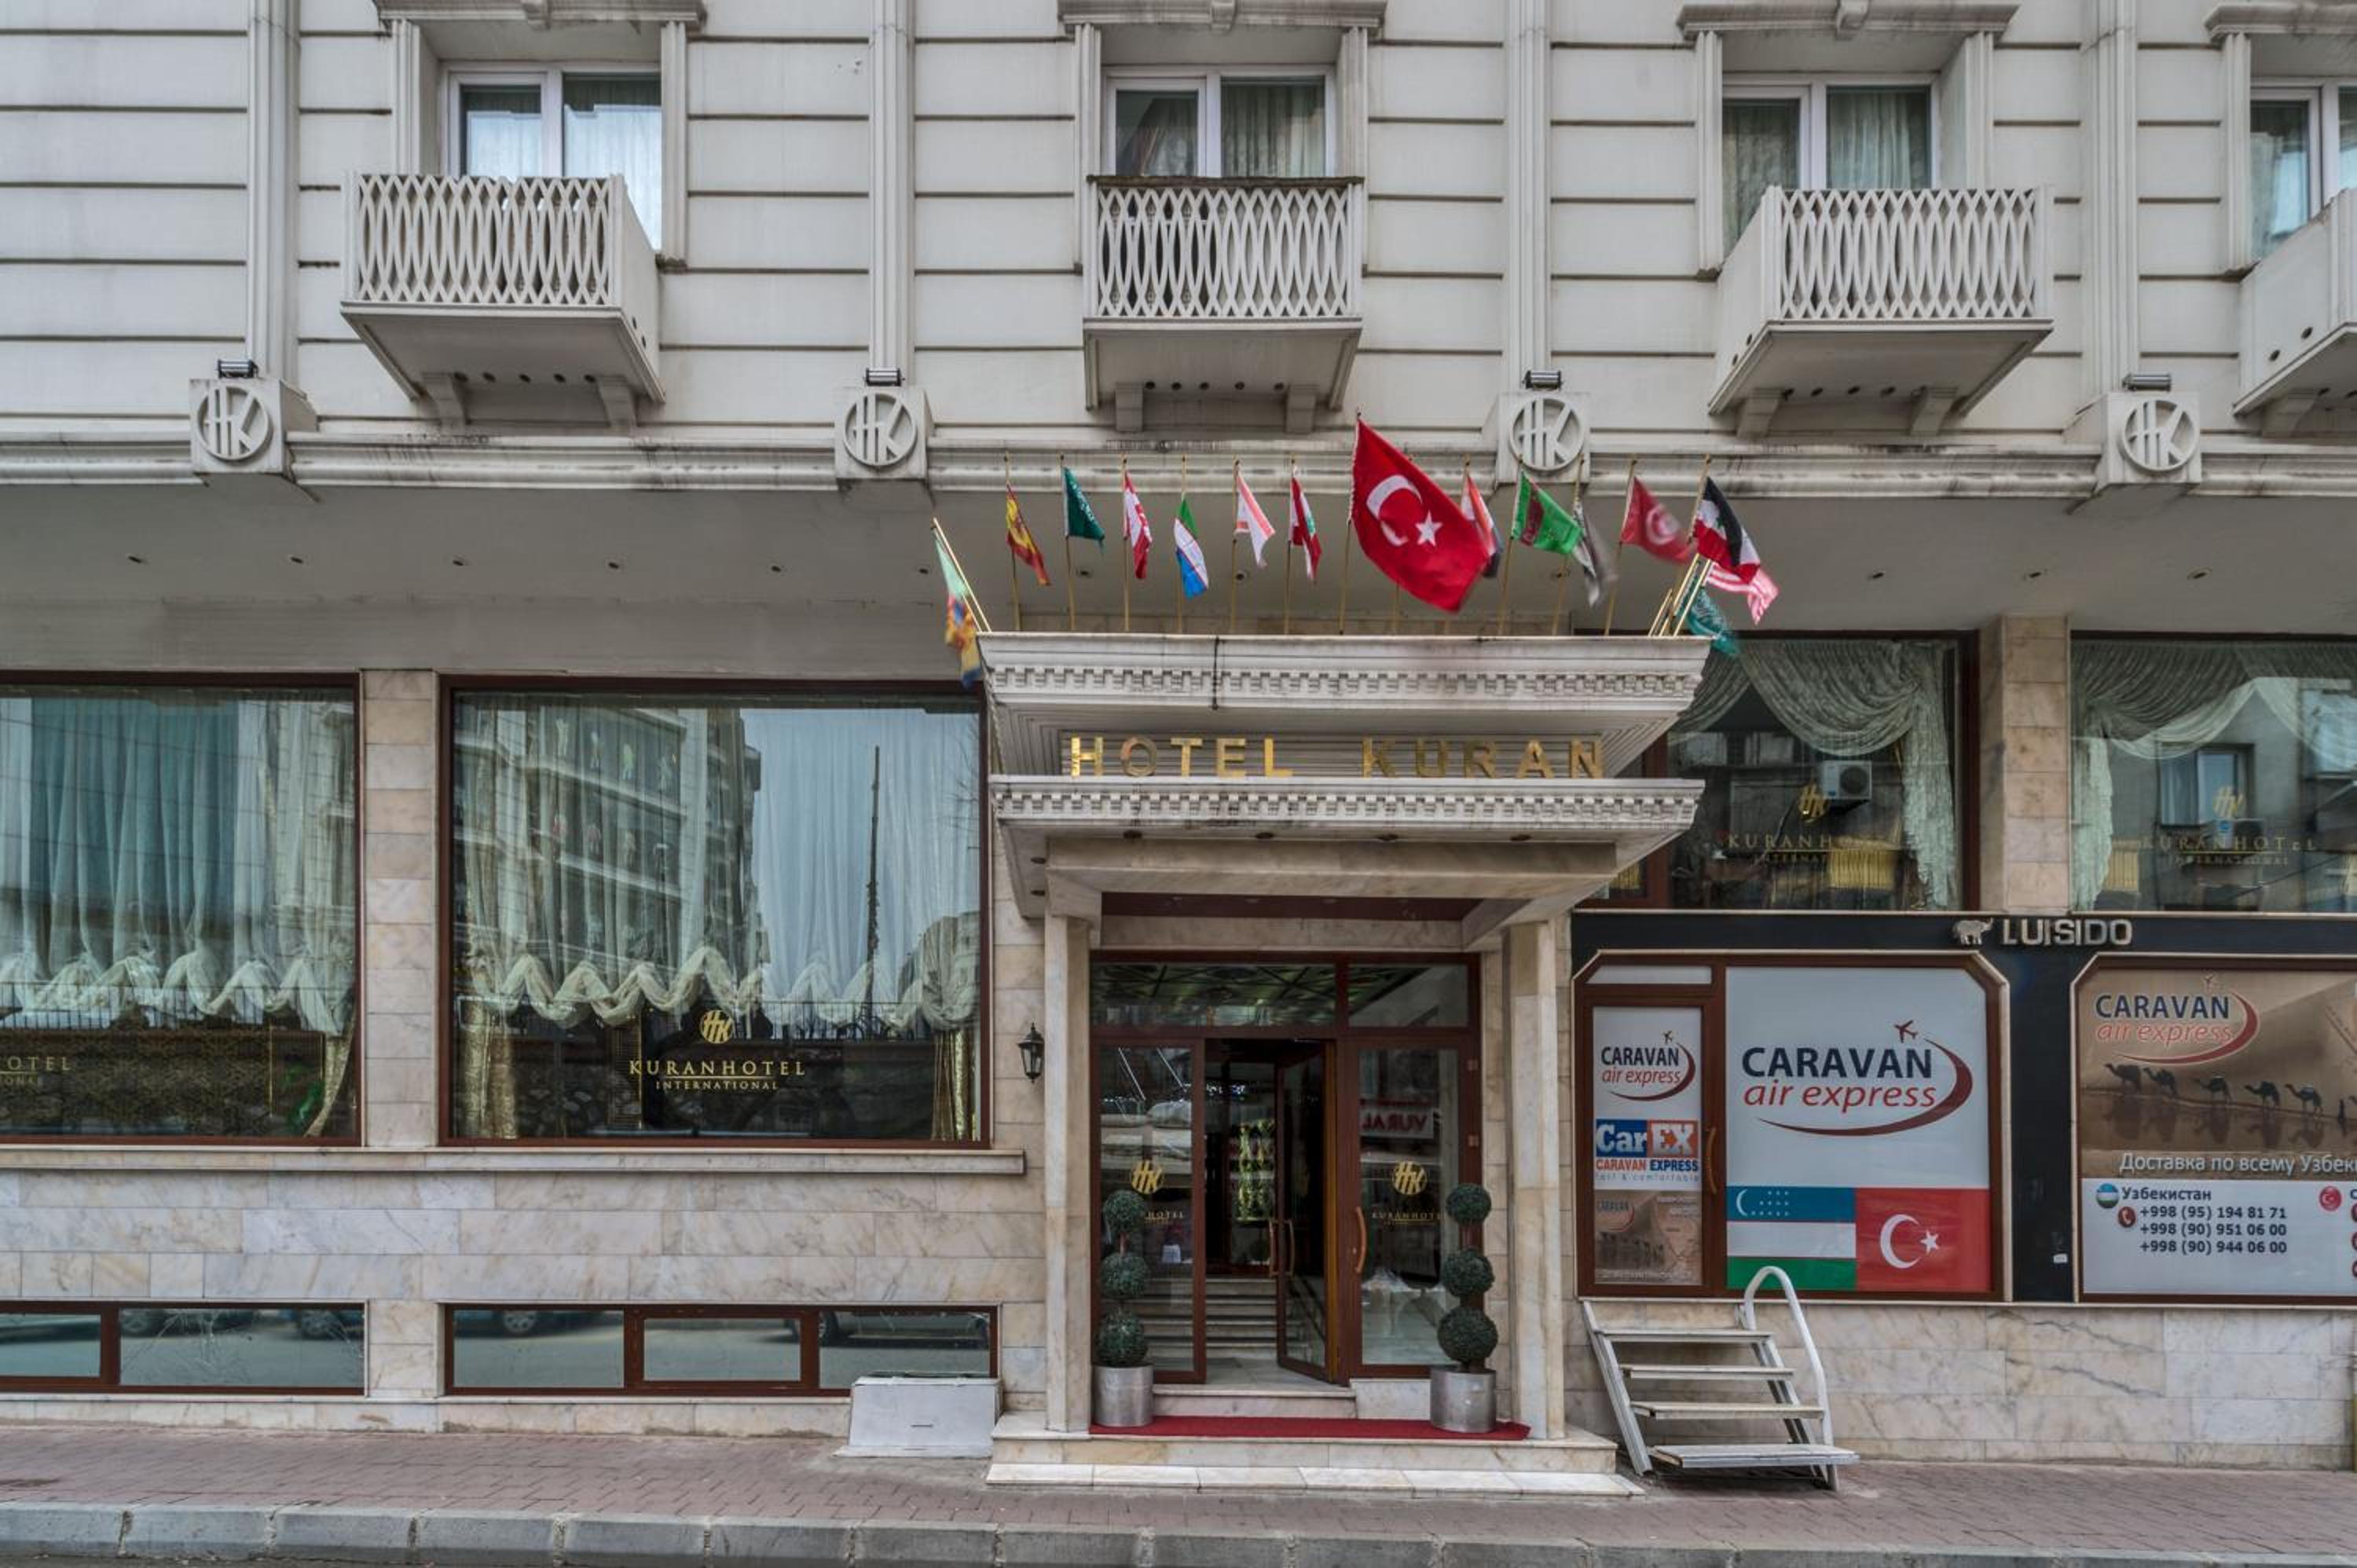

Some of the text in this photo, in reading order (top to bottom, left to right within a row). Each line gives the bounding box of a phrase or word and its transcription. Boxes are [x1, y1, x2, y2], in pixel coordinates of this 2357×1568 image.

[1070, 736, 1604, 779] HOTEL KURAN
[2003, 918, 2133, 946] LUISIDO
[2095, 995, 2229, 1019] CARAVAN
[2096, 1023, 2233, 1046] air express
[1601, 1046, 1679, 1066] CARAVAN
[1742, 1047, 1932, 1079] CARAVAN
[630, 1061, 805, 1075] KURANHOTEL
[1602, 1067, 1681, 1087] air express
[656, 1080, 779, 1090] INTERNATIONAL
[1743, 1079, 1937, 1114] air express
[1596, 1159, 1699, 1171] CARAVAN EXPRESS
[2120, 1152, 2205, 1174] Доставка
[2212, 1157, 2234, 1171] по
[2239, 1157, 2295, 1176] всему
[2121, 1186, 2212, 1201] Узбекистан
[2140, 1206, 2287, 1221] +998 (95) 194 81 71
[2140, 1223, 2176, 1235] +998
[2216, 1223, 2242, 1236] 951
[2247, 1224, 2264, 1236] 06
[2269, 1224, 2287, 1236] 00
[2140, 1240, 2176, 1252] +998
[2216, 1240, 2242, 1253] 944
[2247, 1241, 2264, 1253] 06
[2269, 1241, 2287, 1253] 00
